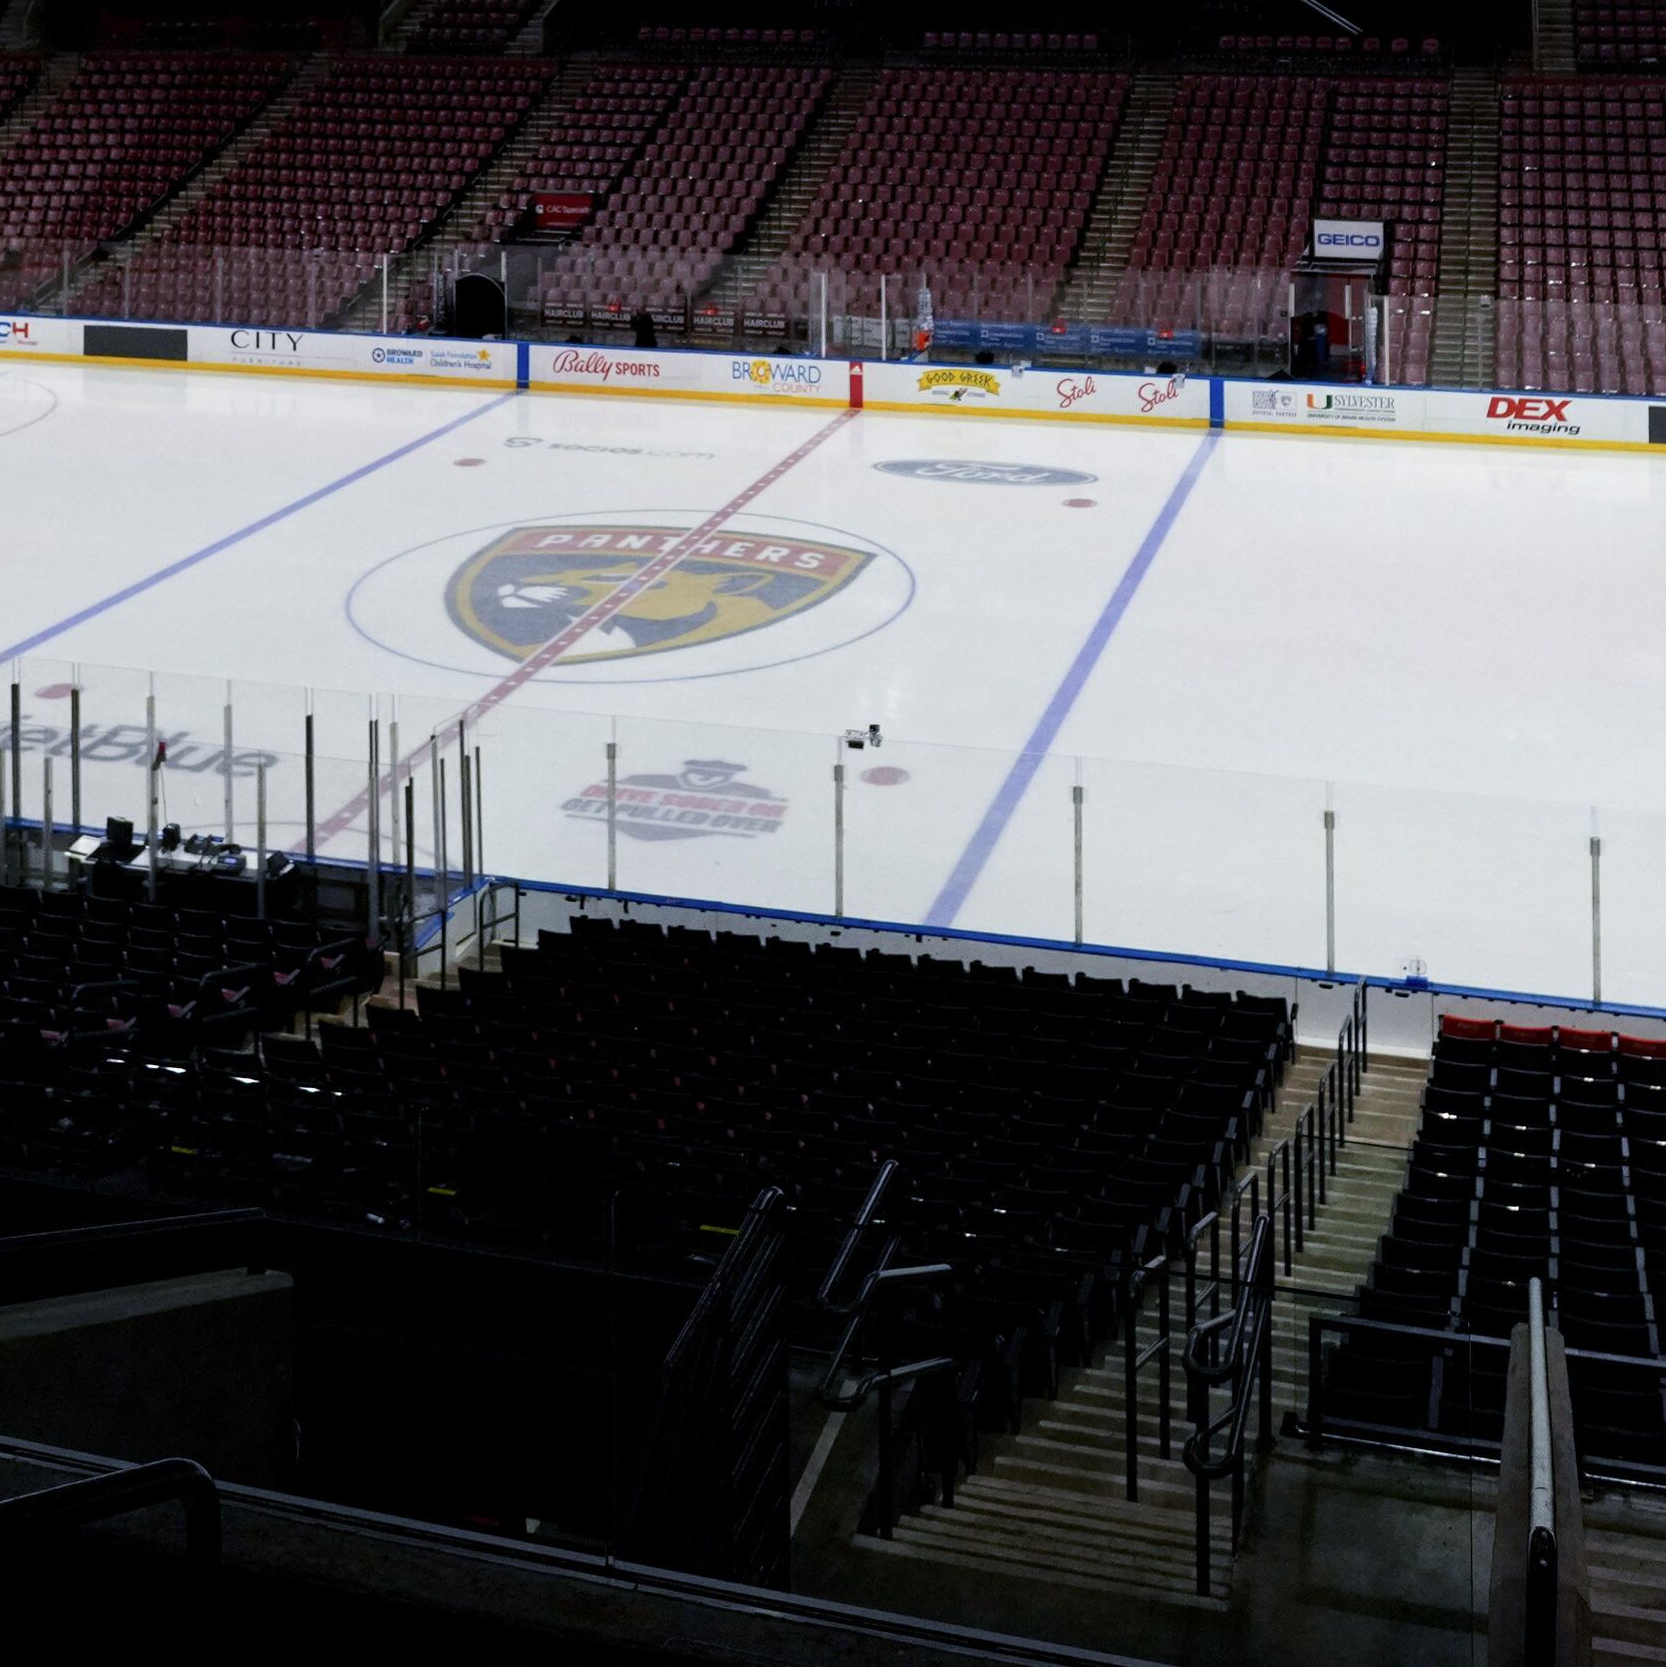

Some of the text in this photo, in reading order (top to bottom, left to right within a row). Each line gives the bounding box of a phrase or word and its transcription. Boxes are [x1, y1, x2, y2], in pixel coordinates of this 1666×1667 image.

[1317, 233, 1380, 247] GEICO
[231, 330, 303, 351] CITY
[386, 349, 423, 357] BROWARD
[386, 356, 414, 365] HEALTH
[553, 349, 660, 381] Bally SPORTS
[733, 360, 821, 384] BROWARD
[773, 383, 822, 395] COUNTY
[926, 372, 993, 389] GOOD GREEK
[1057, 376, 1097, 408] Stoli
[1139, 380, 1179, 413] Stoli
[1334, 395, 1395, 410] SYLVESTER
[1487, 397, 1572, 421] DEX
[1507, 421, 1580, 435] imaging
[916, 461, 1051, 485] Ford
[533, 533, 825, 570] PANTHERS
